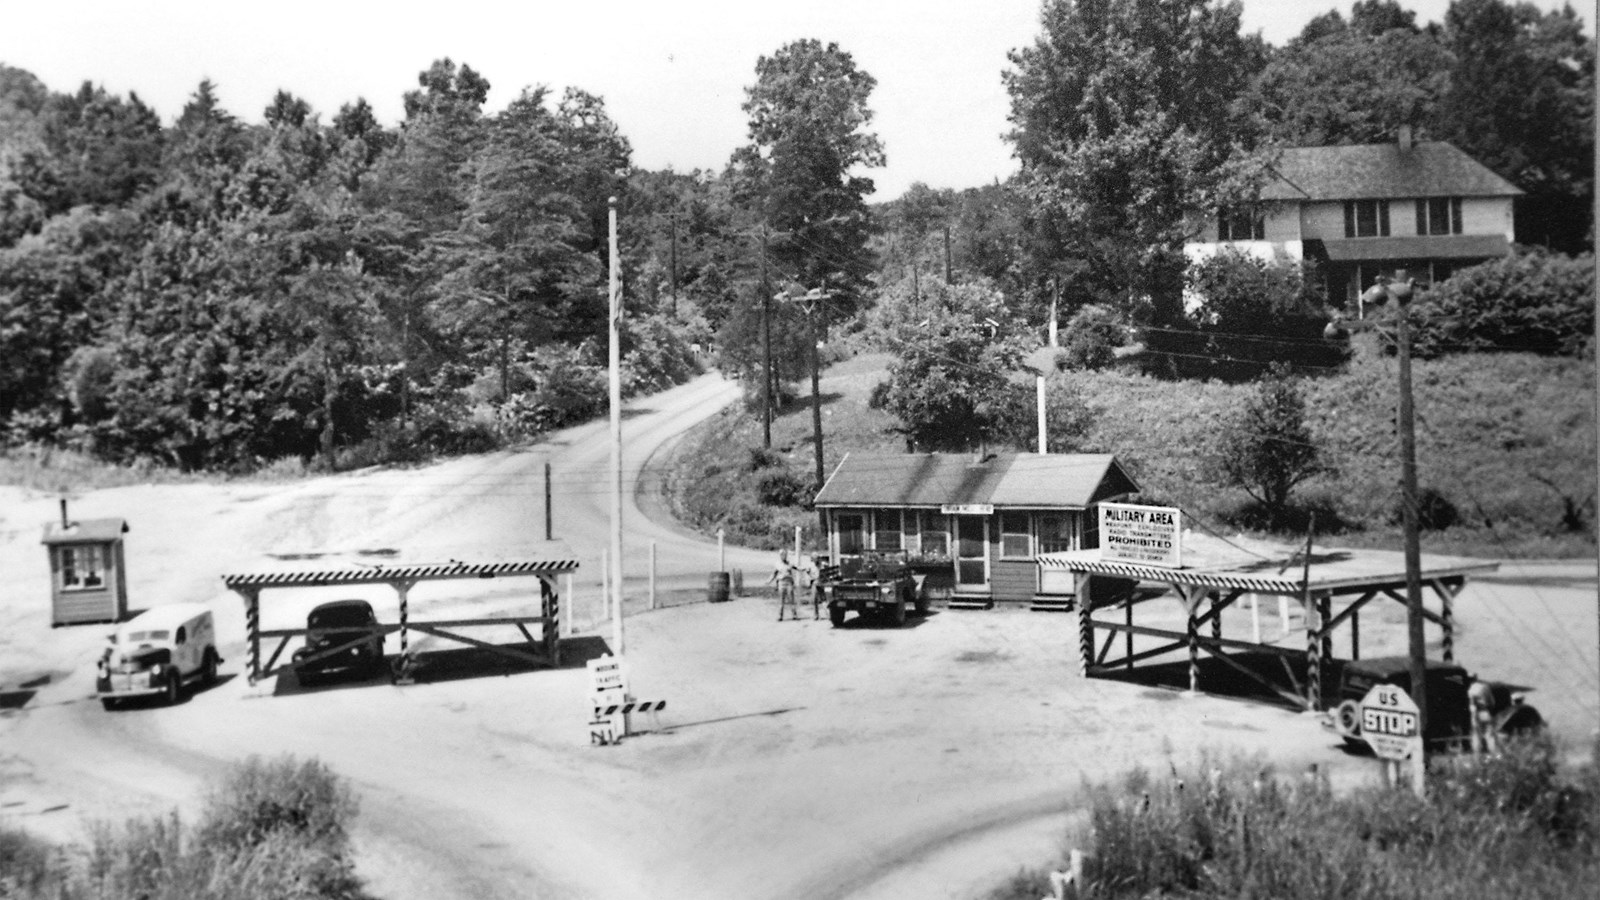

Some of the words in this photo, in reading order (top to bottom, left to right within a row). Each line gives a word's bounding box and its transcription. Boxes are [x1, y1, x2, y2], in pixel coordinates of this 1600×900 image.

[1105, 509, 1145, 523] MILITARY
[1149, 512, 1174, 525] AREA
[1108, 535, 1172, 549] PROHIBITED
[1364, 709, 1415, 736] STOP
